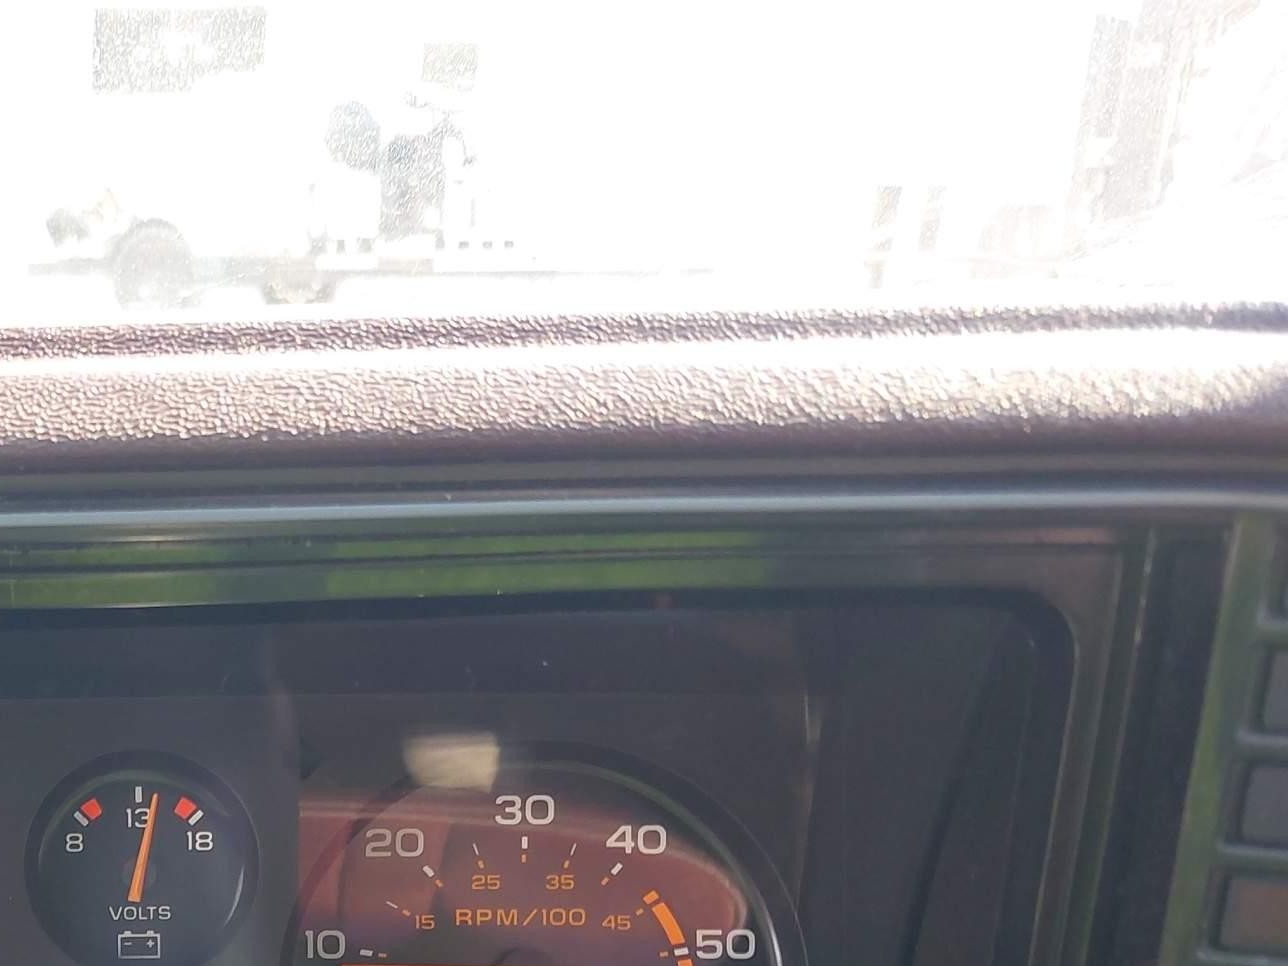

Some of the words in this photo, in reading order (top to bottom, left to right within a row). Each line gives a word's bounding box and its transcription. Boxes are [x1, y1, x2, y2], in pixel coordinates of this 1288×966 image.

[126, 808, 150, 829] 13
[495, 795, 555, 825] 30
[65, 833, 84, 852] 8
[186, 832, 213, 852] 18
[365, 829, 424, 858] 20
[606, 825, 667, 855] 40
[471, 875, 501, 891] 25
[545, 875, 575, 891] 35
[109, 905, 171, 921] VOLTS
[415, 915, 435, 930] 15
[455, 909, 587, 928] RPM/100
[602, 915, 631, 930] 45
[305, 930, 346, 959] 10
[695, 929, 756, 960] 50
